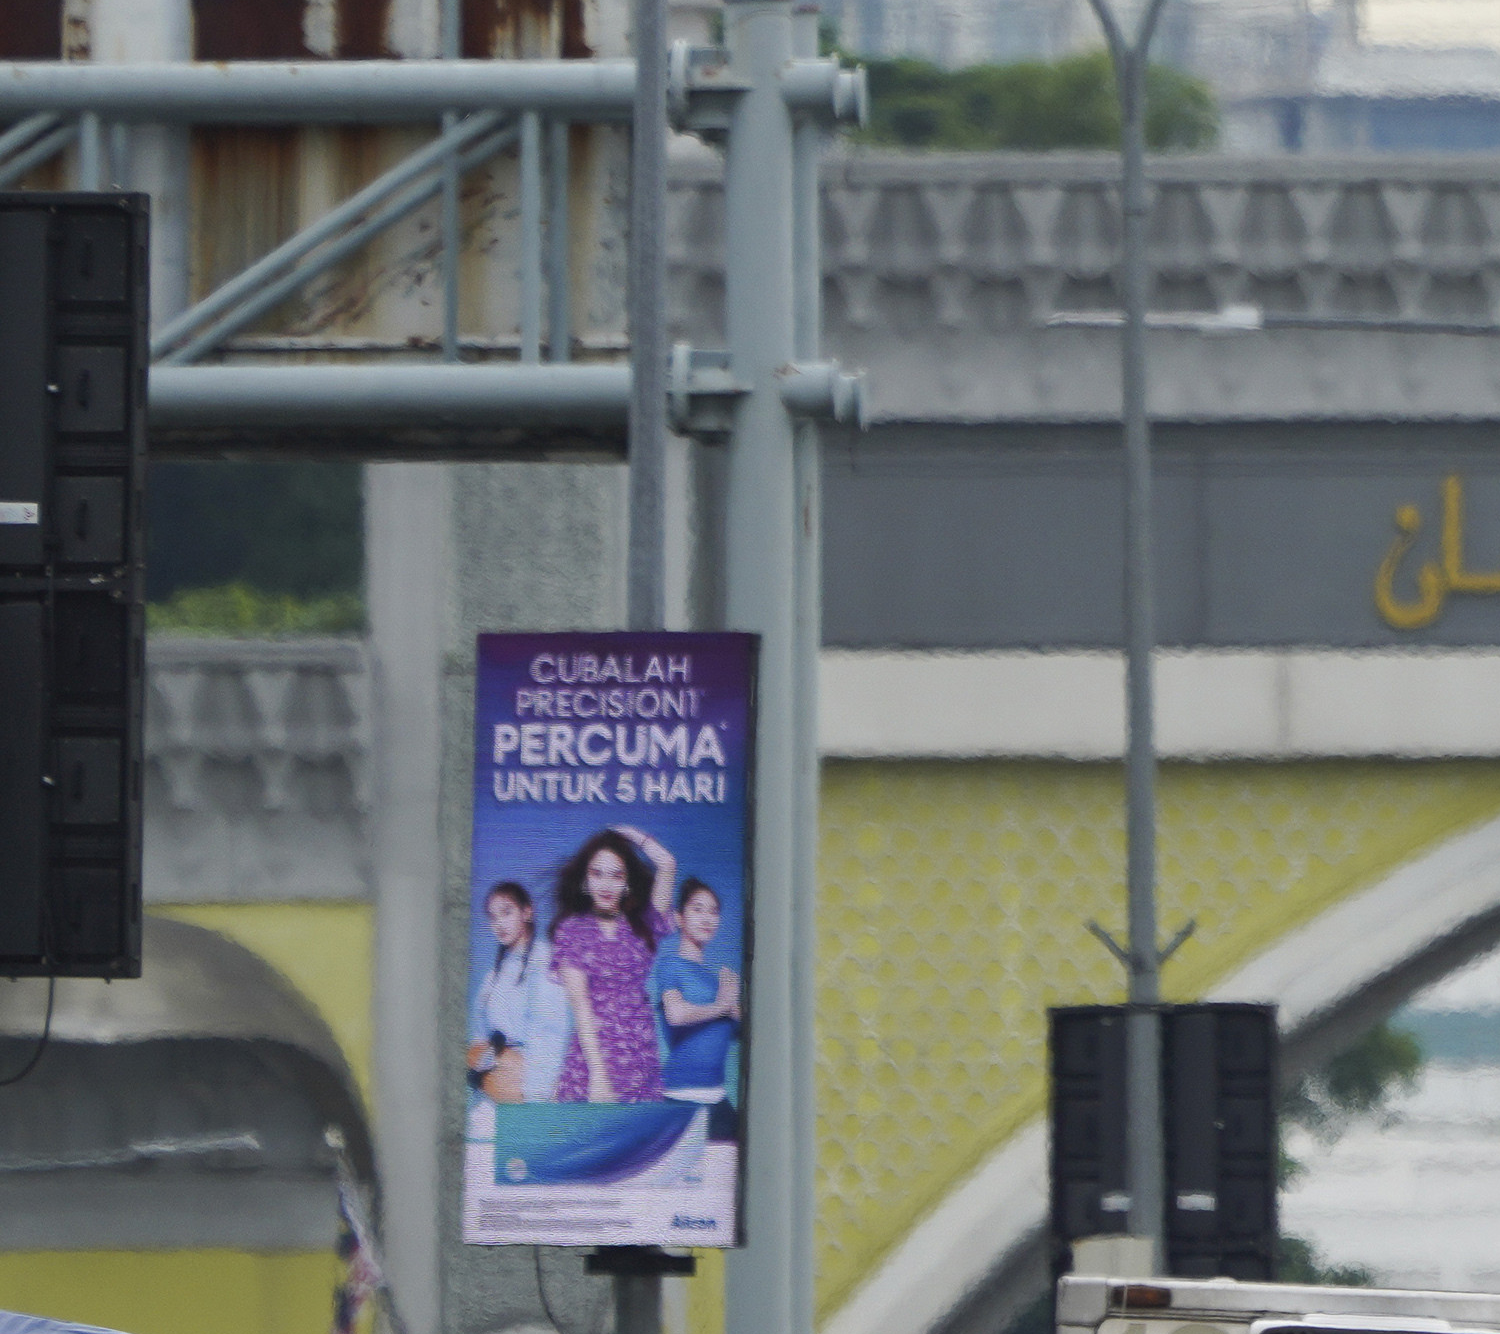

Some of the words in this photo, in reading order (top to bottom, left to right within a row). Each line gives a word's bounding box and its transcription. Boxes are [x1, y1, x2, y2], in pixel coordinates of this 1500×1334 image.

[529, 653, 691, 684] CUBALAH
[493, 771, 609, 803] UNTUK
[615, 772, 637, 803] 5
[643, 771, 727, 804] HARI
